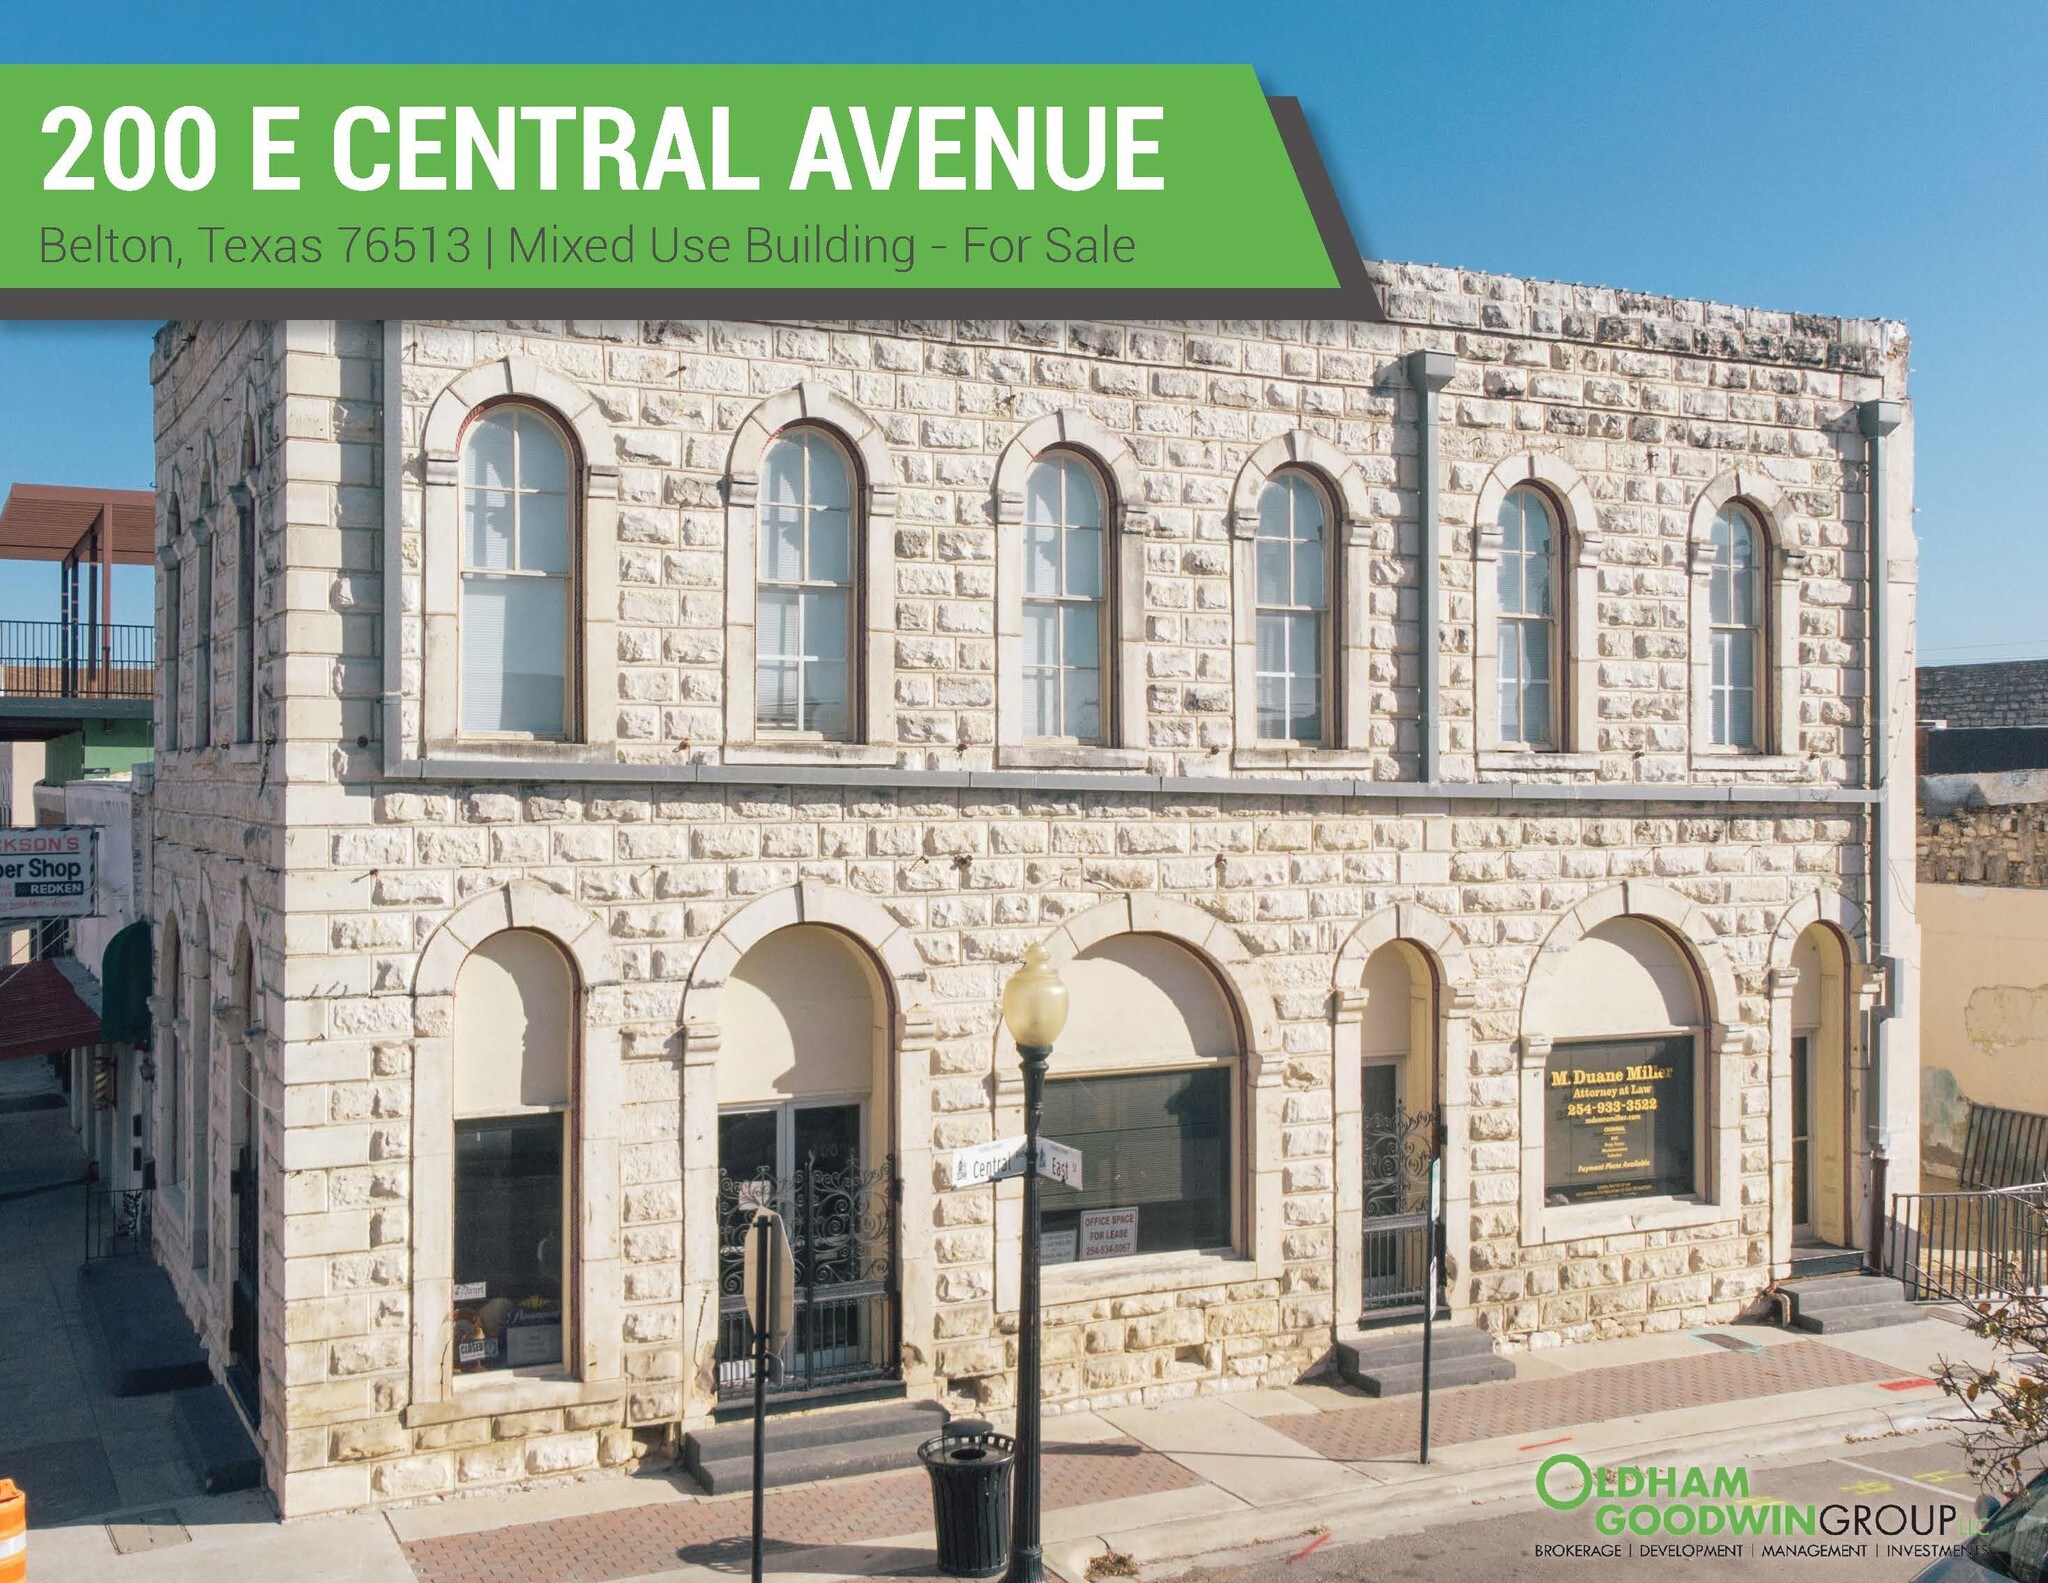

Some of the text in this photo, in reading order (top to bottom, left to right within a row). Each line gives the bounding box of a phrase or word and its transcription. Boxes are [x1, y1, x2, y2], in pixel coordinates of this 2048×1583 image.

[29, 858, 81, 880] Shop
[30, 883, 81, 894] REDKEN
[1551, 1065, 1673, 1087] M. Duane Miller
[1573, 1084, 1652, 1099] Attorney at Law
[1567, 1098, 1658, 1116] 254-933-3522
[973, 1152, 1012, 1179] Central
[1051, 1156, 1069, 1180] East
[1578, 1164, 1605, 1174] Payment
[1085, 1213, 1135, 1227] OFFICE SPACE
[1089, 1228, 1129, 1241] FOR LEASE
[460, 1341, 484, 1354] CLOSED
